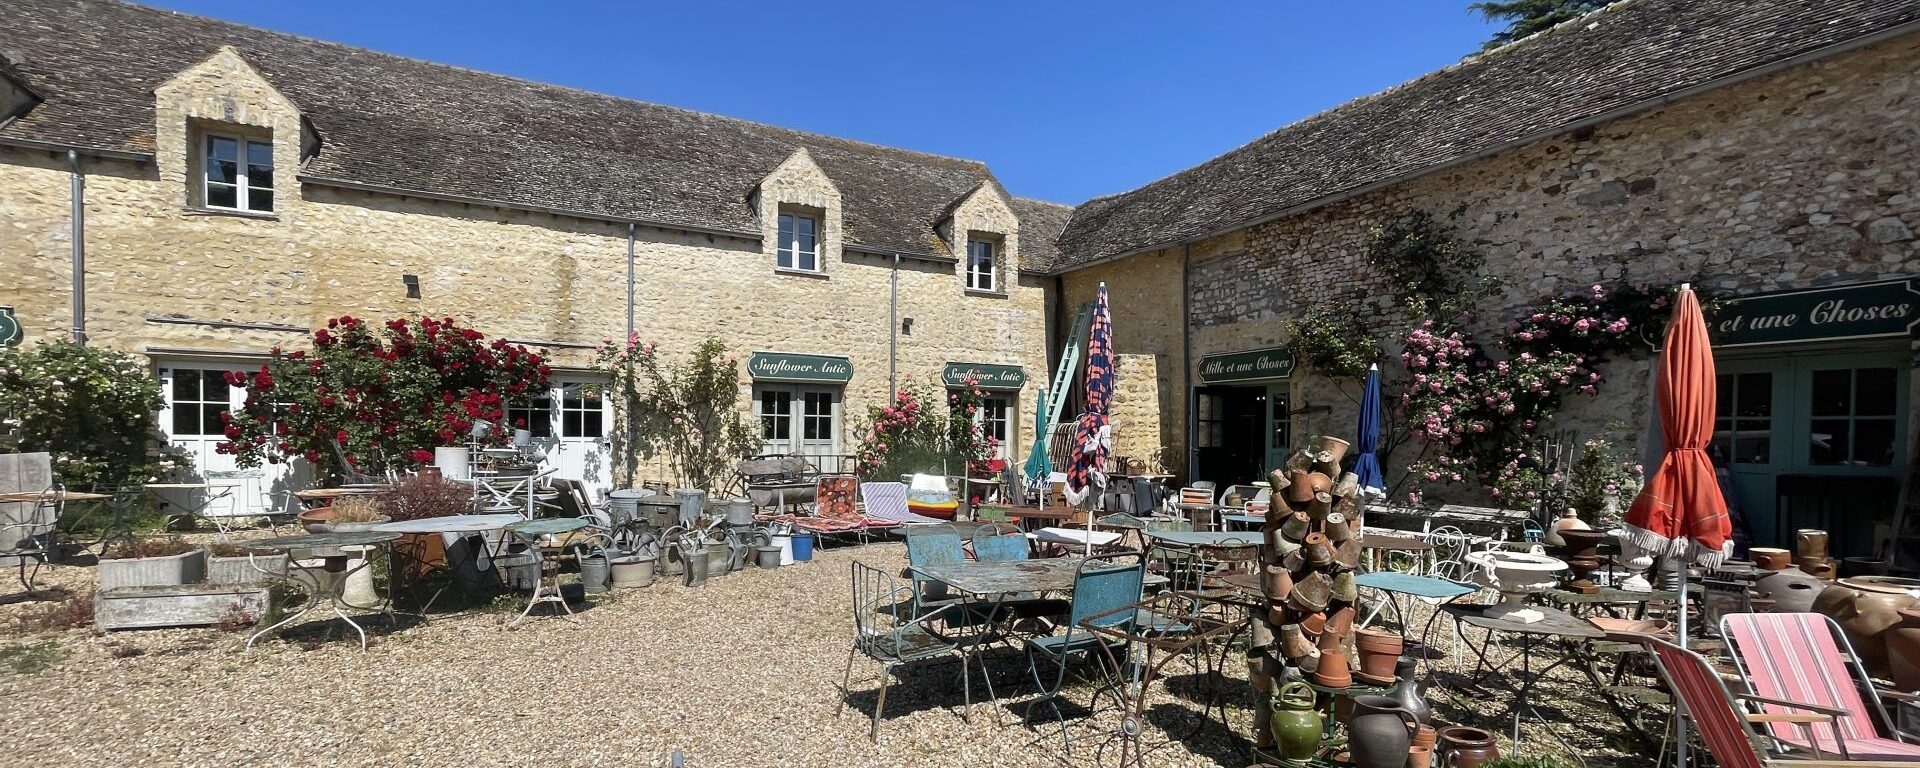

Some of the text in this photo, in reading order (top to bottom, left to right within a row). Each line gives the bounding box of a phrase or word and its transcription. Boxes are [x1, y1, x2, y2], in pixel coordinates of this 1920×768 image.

[1719, 313, 1745, 332] et
[1750, 311, 1799, 330] une
[1809, 299, 1910, 325] Choses
[754, 358, 846, 374] Sunflower Antic
[1201, 355, 1290, 375] Mille et une Choses
[947, 367, 1021, 382] Sunflower Antic
